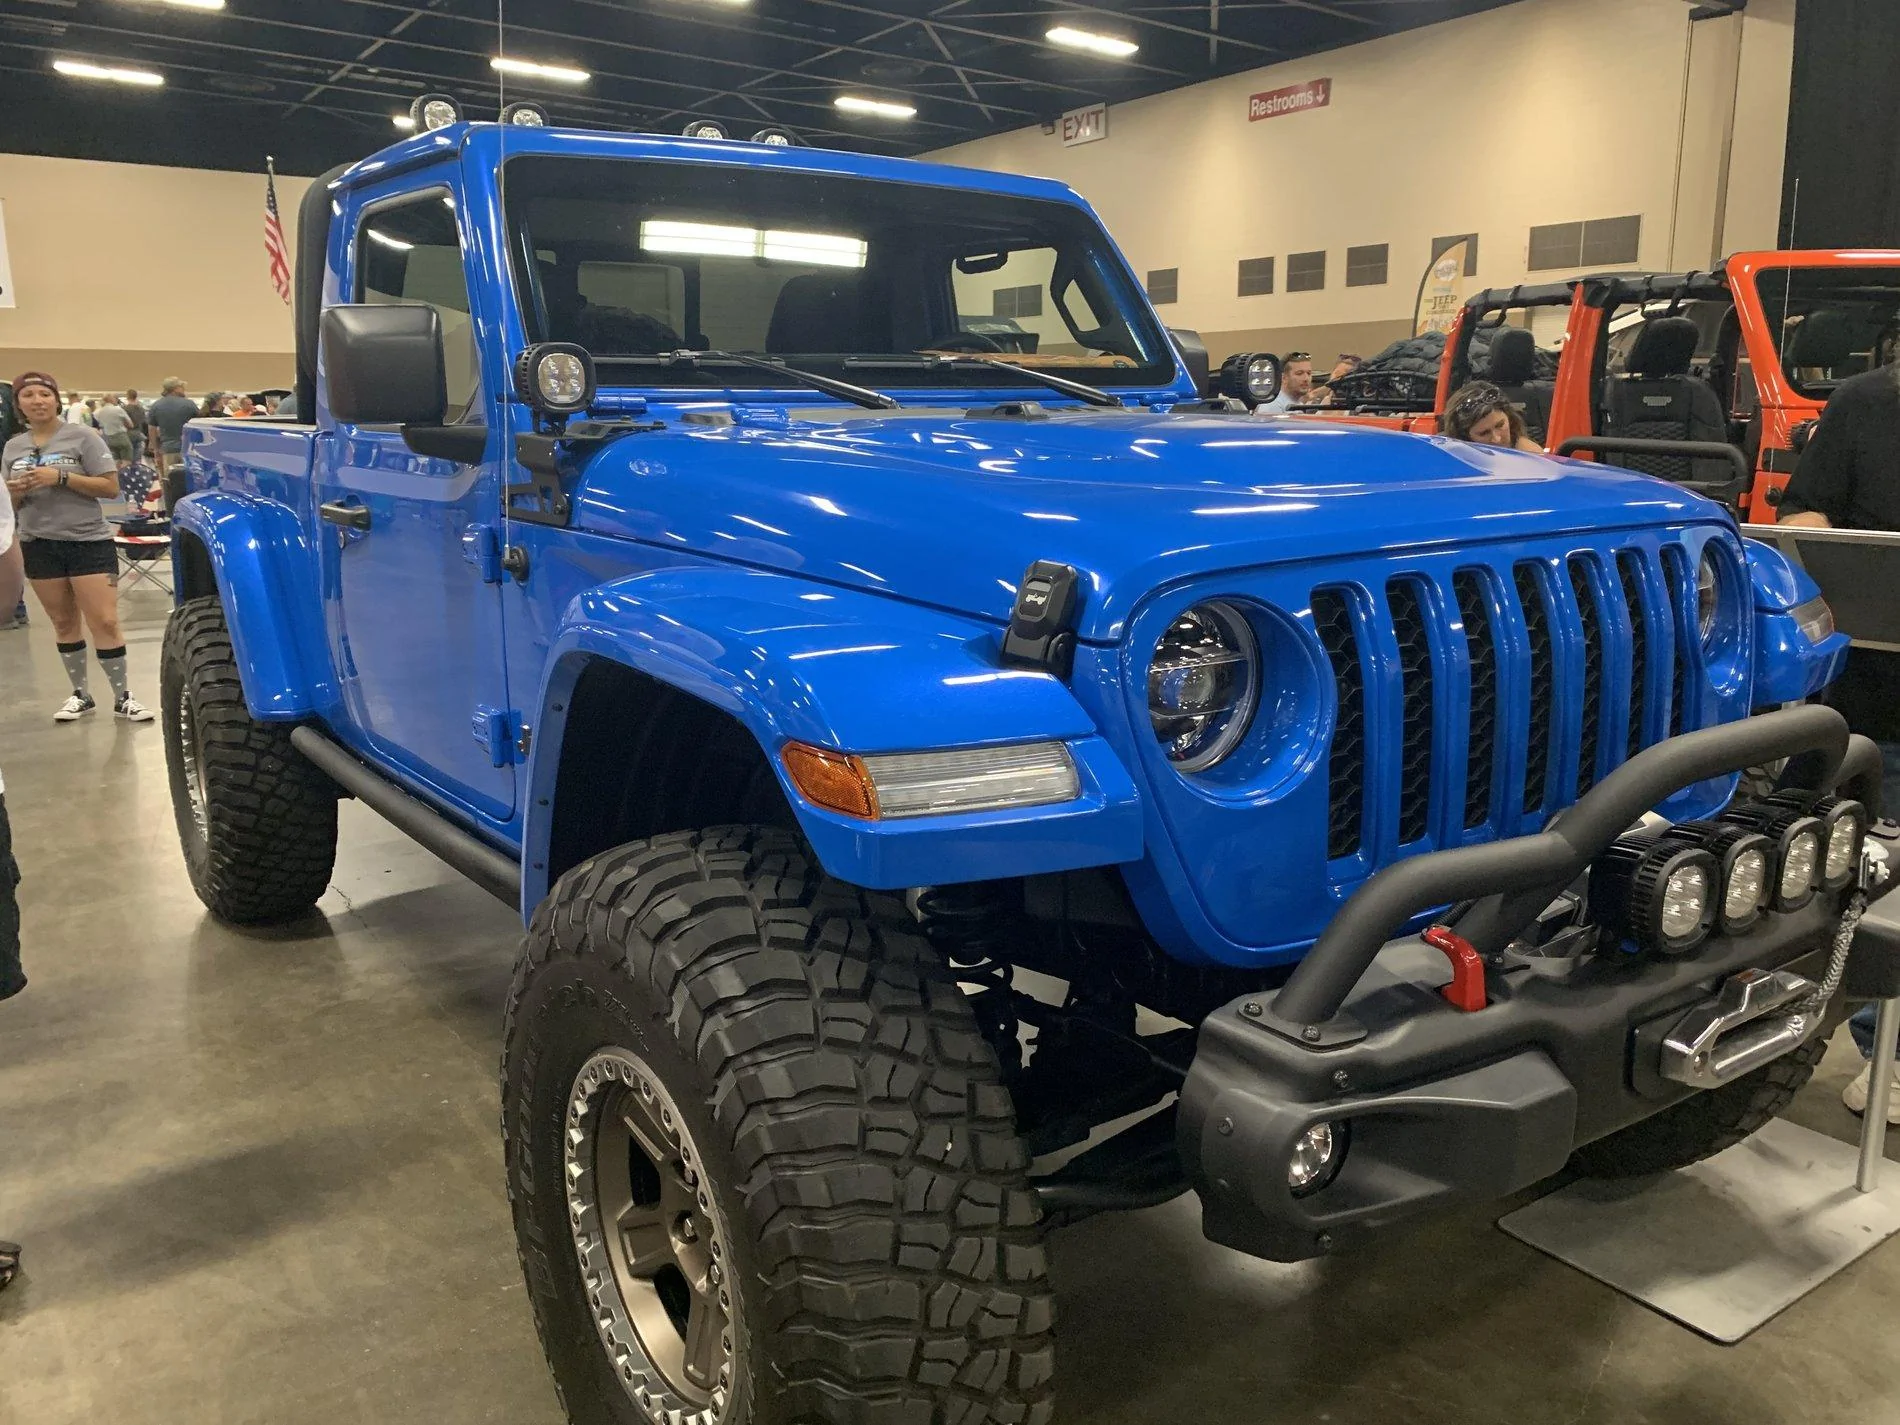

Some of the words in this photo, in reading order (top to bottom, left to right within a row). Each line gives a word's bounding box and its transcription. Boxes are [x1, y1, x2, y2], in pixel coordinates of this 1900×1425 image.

[1250, 90, 1314, 117] Restrooms
[1063, 109, 1104, 142] EXIT
[1432, 294, 1458, 310] JEEP
